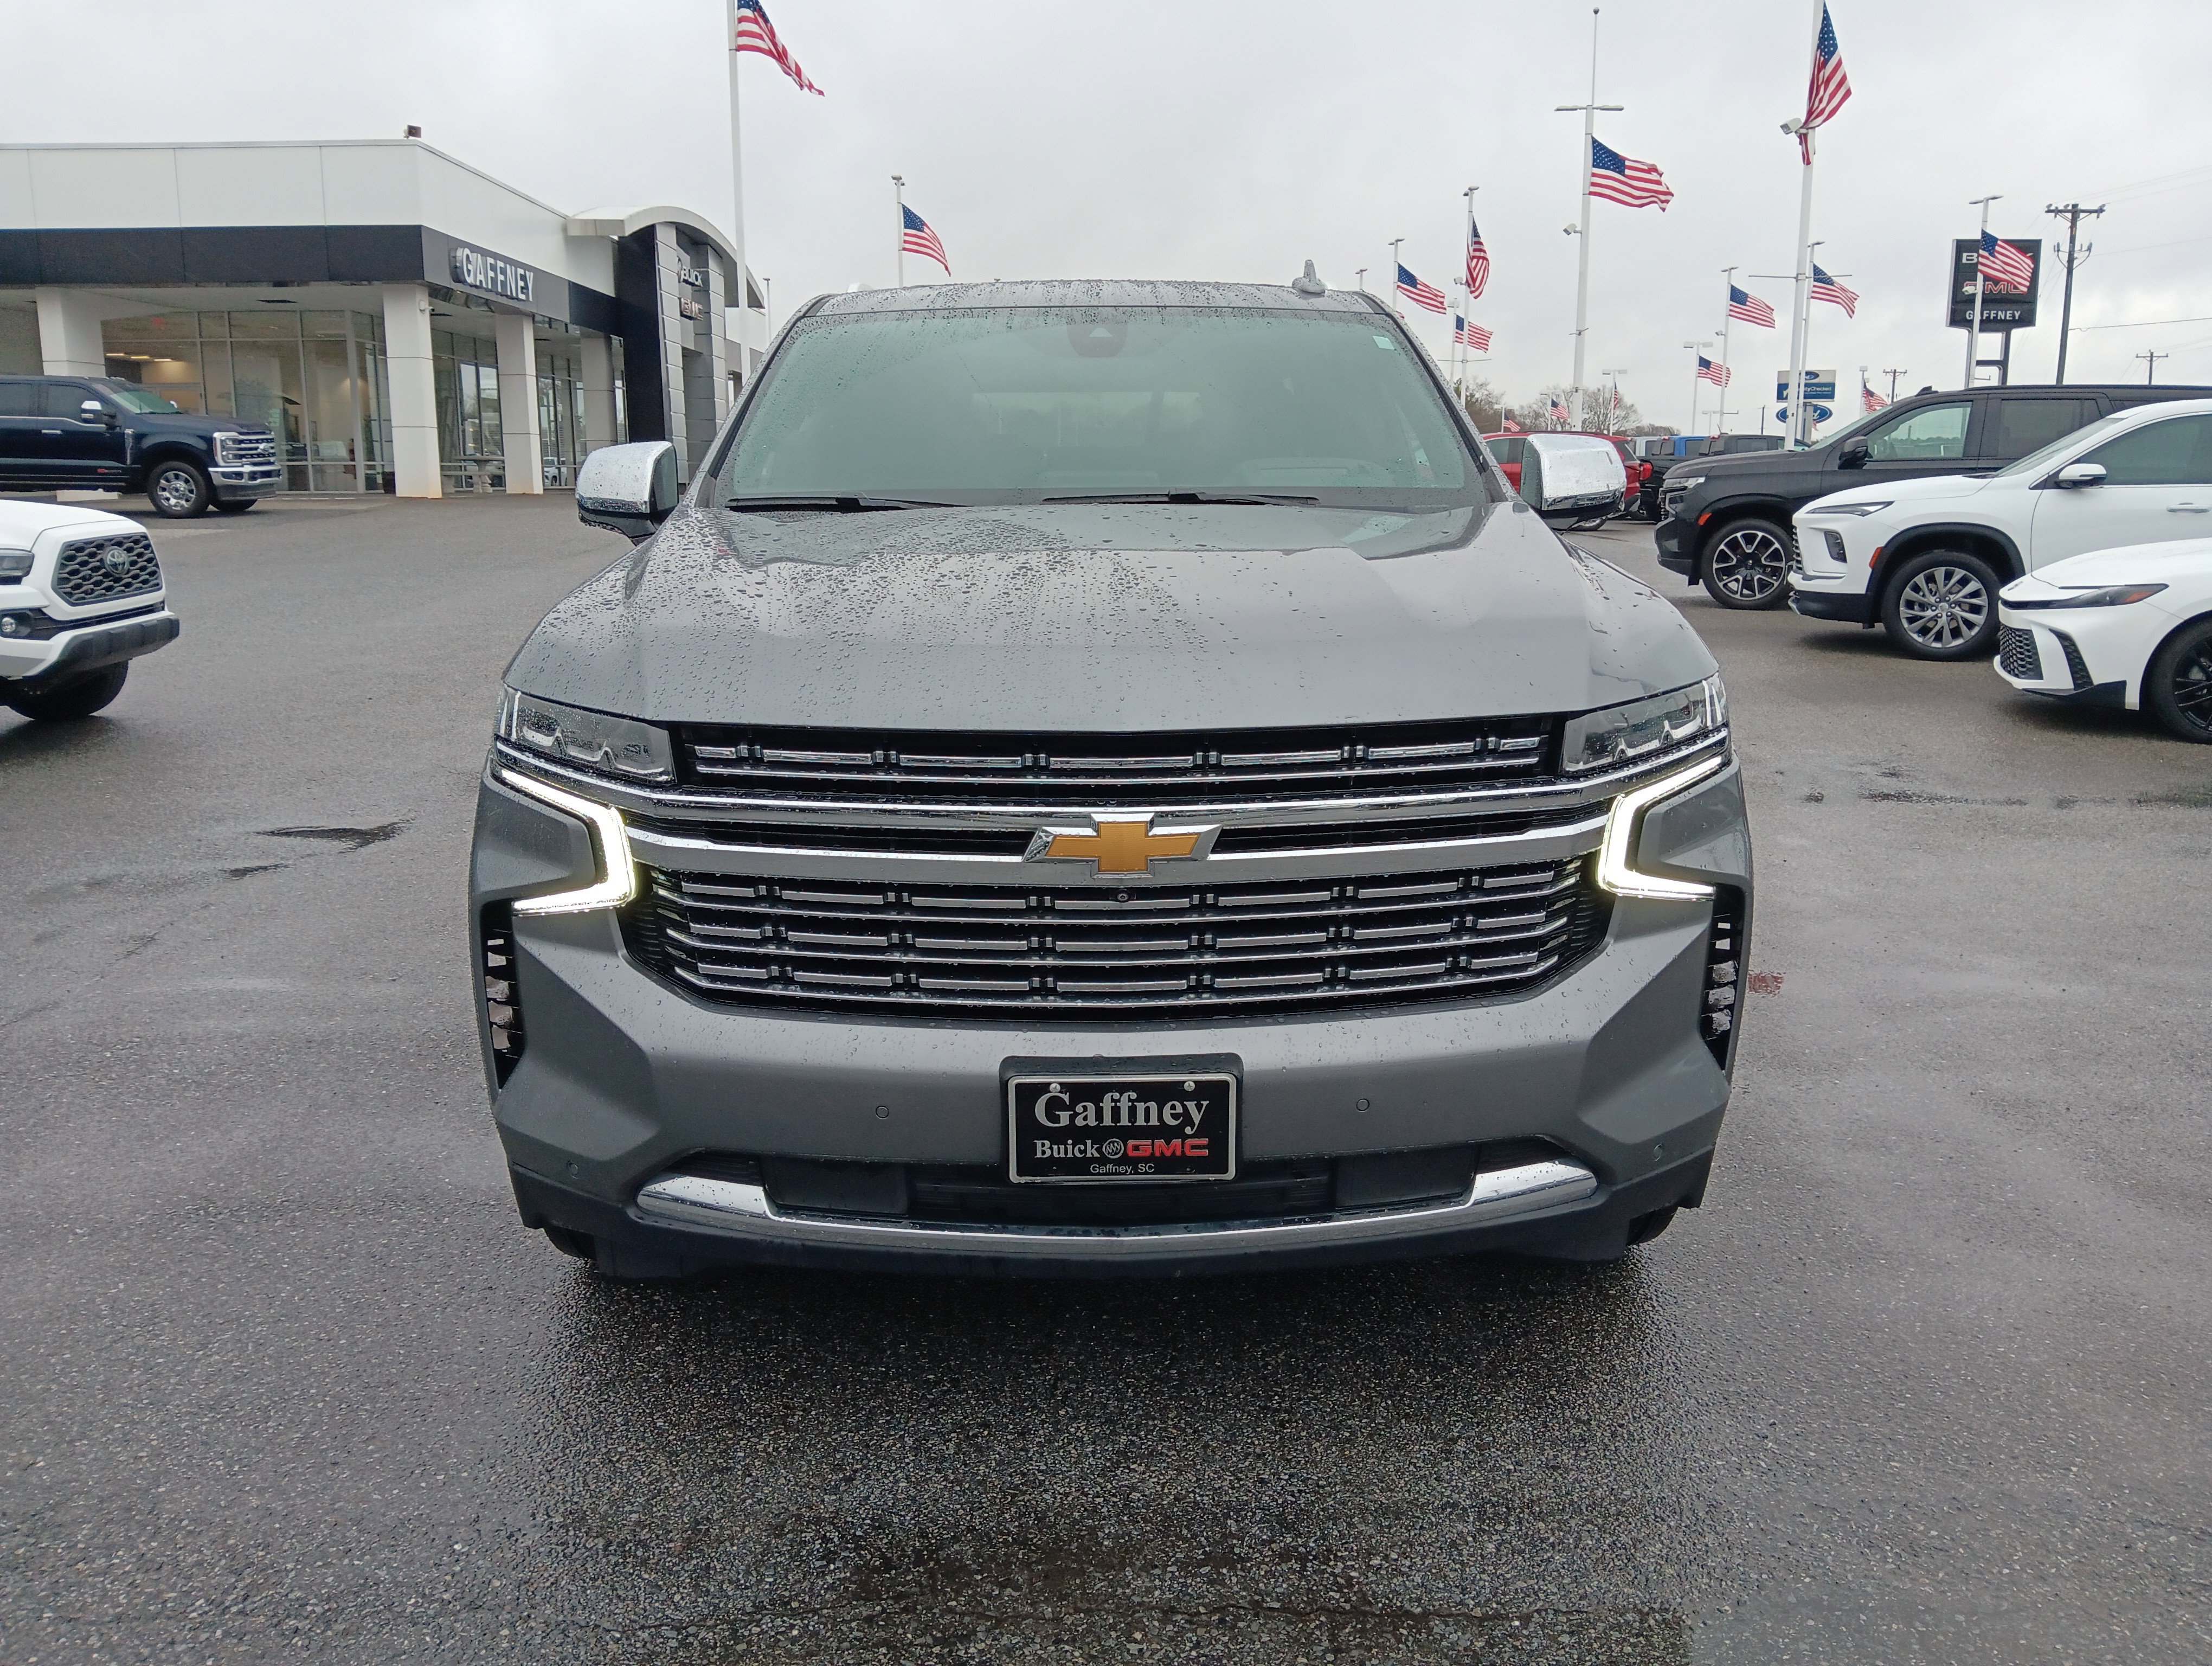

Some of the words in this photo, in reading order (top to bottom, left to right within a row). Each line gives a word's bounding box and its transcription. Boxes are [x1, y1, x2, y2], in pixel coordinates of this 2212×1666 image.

[462, 247, 533, 302] GAFFNEY
[1966, 310, 2021, 320] GFFNEY
[1035, 1092, 1209, 1135] Gaffney
[1034, 1139, 1100, 1158] Buick
[1127, 1138, 1208, 1157] GMC
[1090, 1163, 1134, 1175] Gaffney,
[1138, 1163, 1154, 1172] SC
